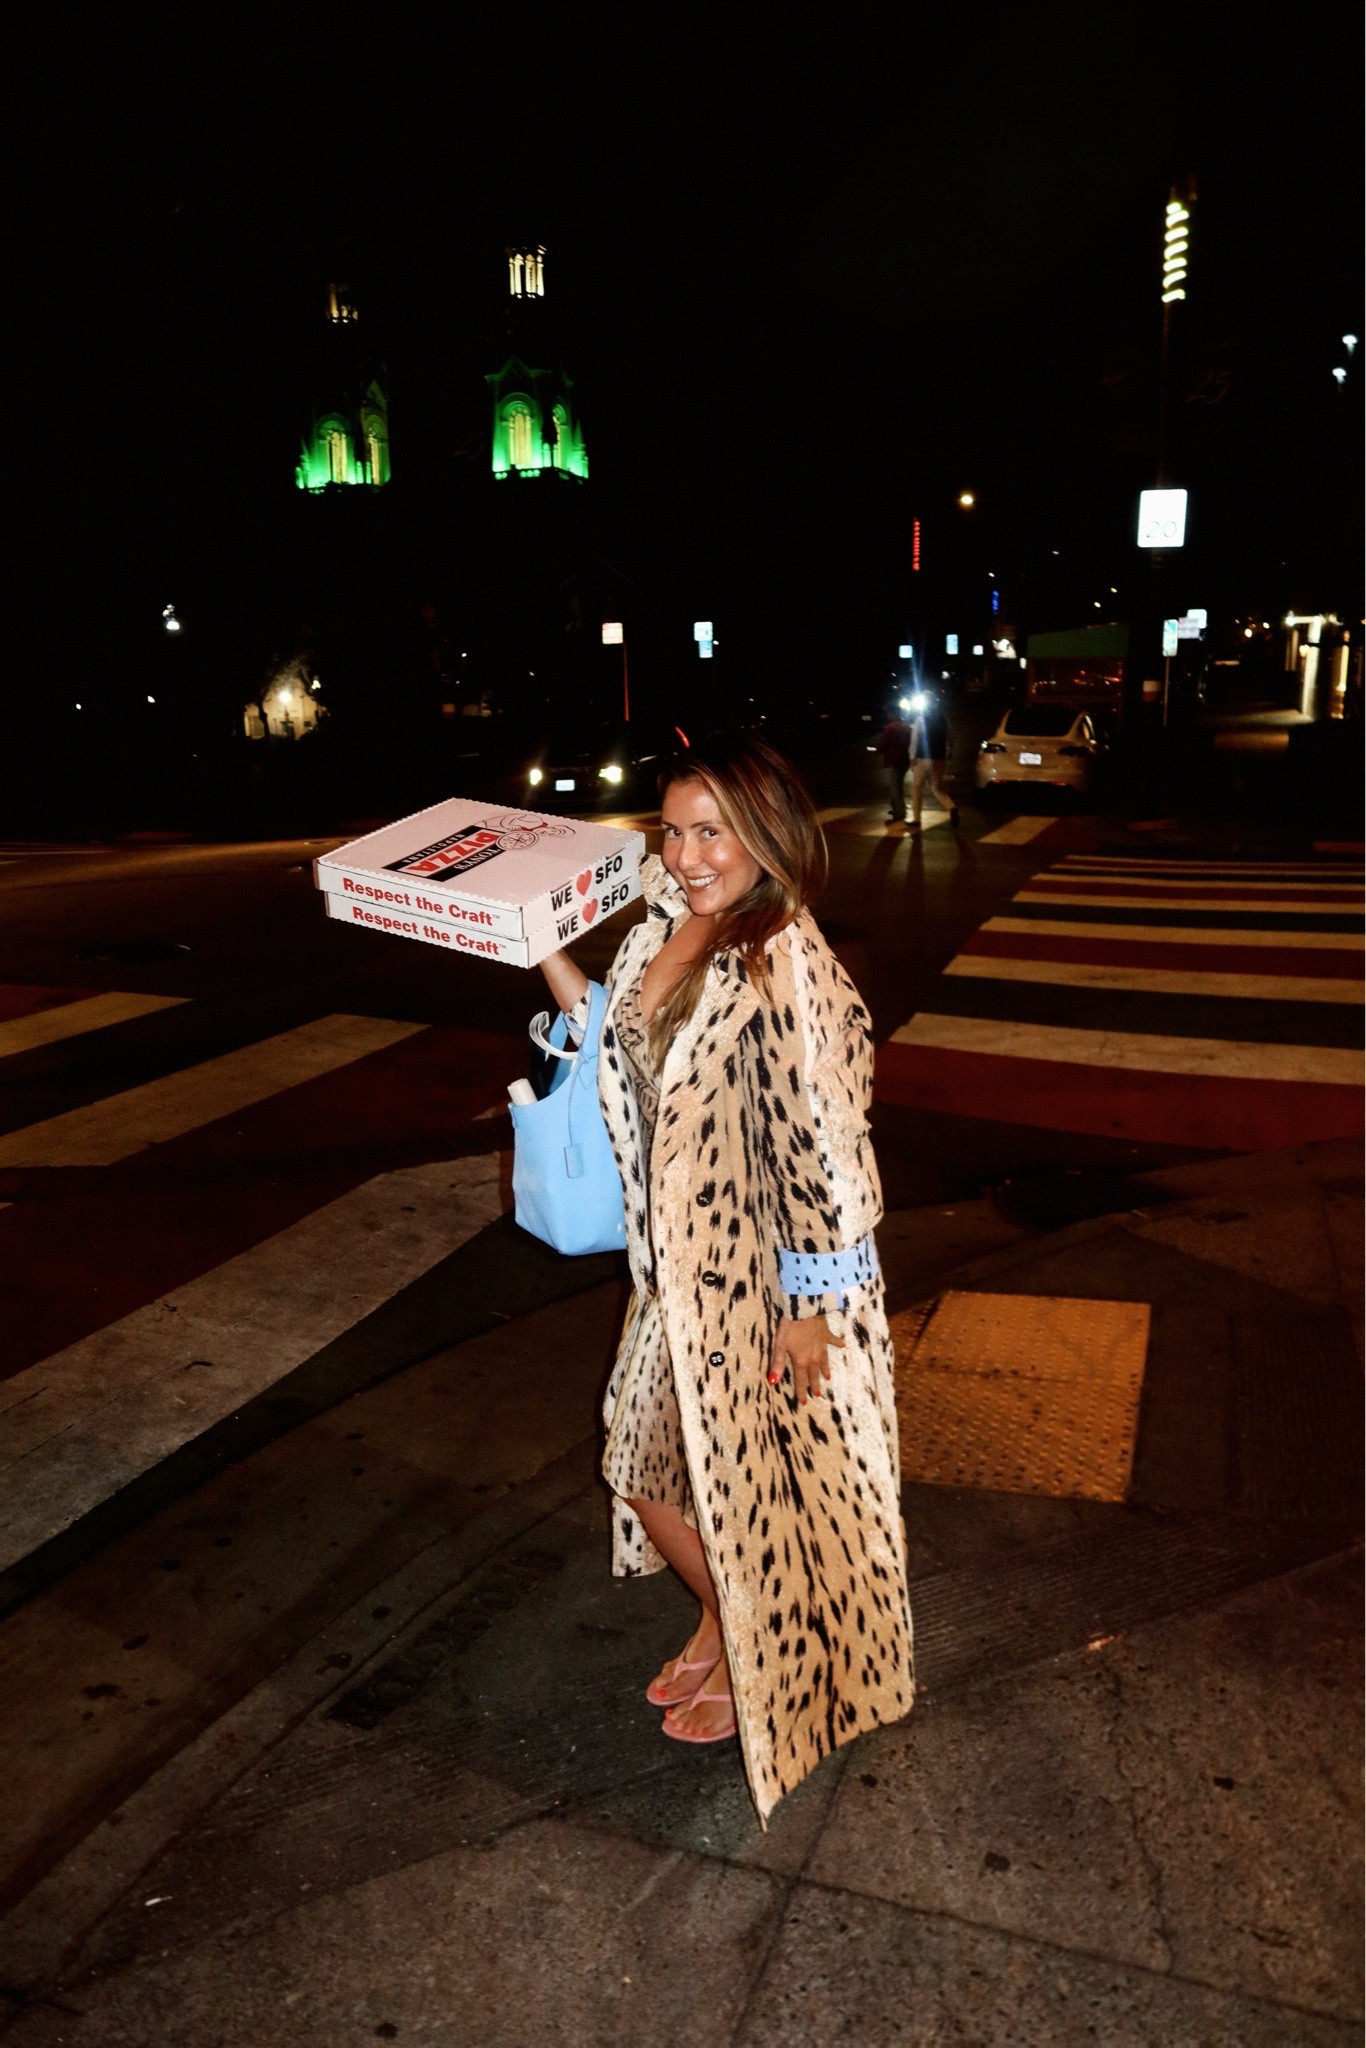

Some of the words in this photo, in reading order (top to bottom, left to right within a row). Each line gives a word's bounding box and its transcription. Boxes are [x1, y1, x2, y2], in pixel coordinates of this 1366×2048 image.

[403, 832, 467, 864] NAPOLETANA
[406, 831, 501, 872] PIZZA
[343, 877, 411, 907] Respect
[415, 896, 444, 914] the
[551, 885, 573, 912] WE
[595, 855, 623, 884] SFO
[352, 906, 419, 935] Respect
[422, 925, 451, 943] the
[557, 914, 579, 941] WE
[601, 883, 629, 913] SFO
